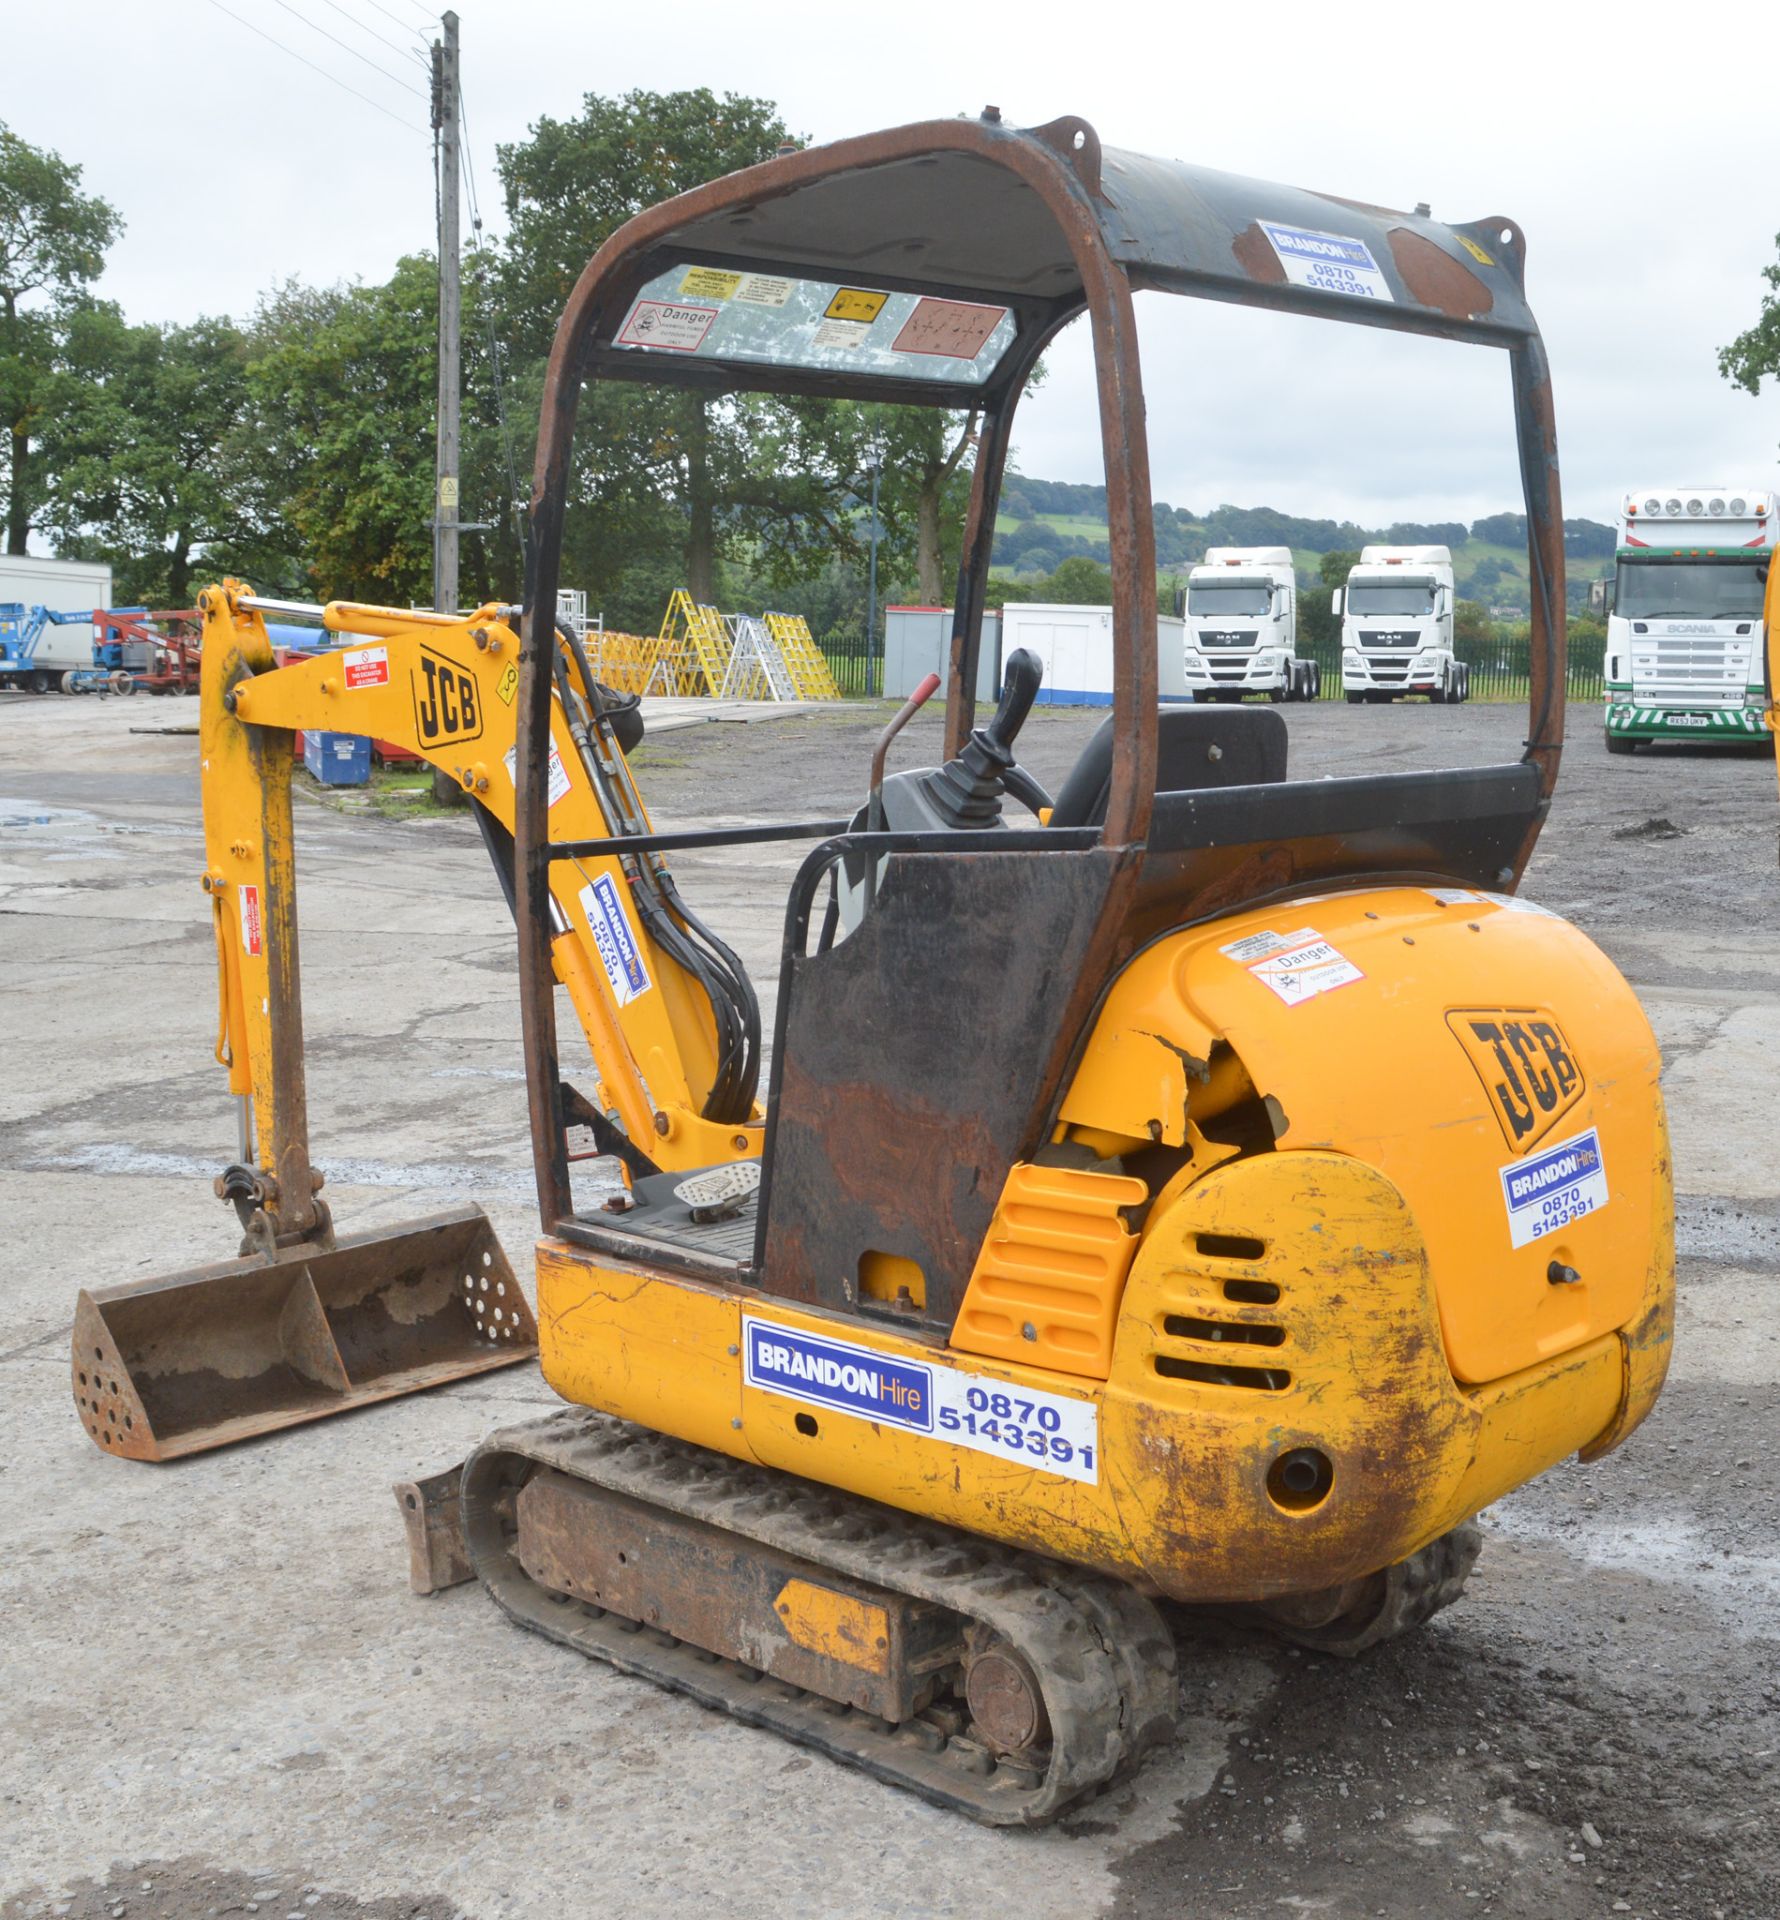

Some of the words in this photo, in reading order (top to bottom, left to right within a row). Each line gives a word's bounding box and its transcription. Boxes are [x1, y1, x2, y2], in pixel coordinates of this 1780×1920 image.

[1306, 274, 1374, 297] 5143391
[1313, 263, 1355, 281] 0870
[662, 307, 713, 324] Danger
[1667, 624, 1716, 634] SCANIA
[420, 656, 476, 738] JCB
[587, 911, 618, 986] 5143391
[599, 920, 618, 967] 0870
[1278, 944, 1333, 968] Danger
[1468, 1022, 1577, 1141] JCB
[1532, 1196, 1594, 1237] 5143391
[1542, 1187, 1580, 1216] 0870
[966, 1387, 1061, 1432] 0870
[939, 1406, 1094, 1470] 5143391
